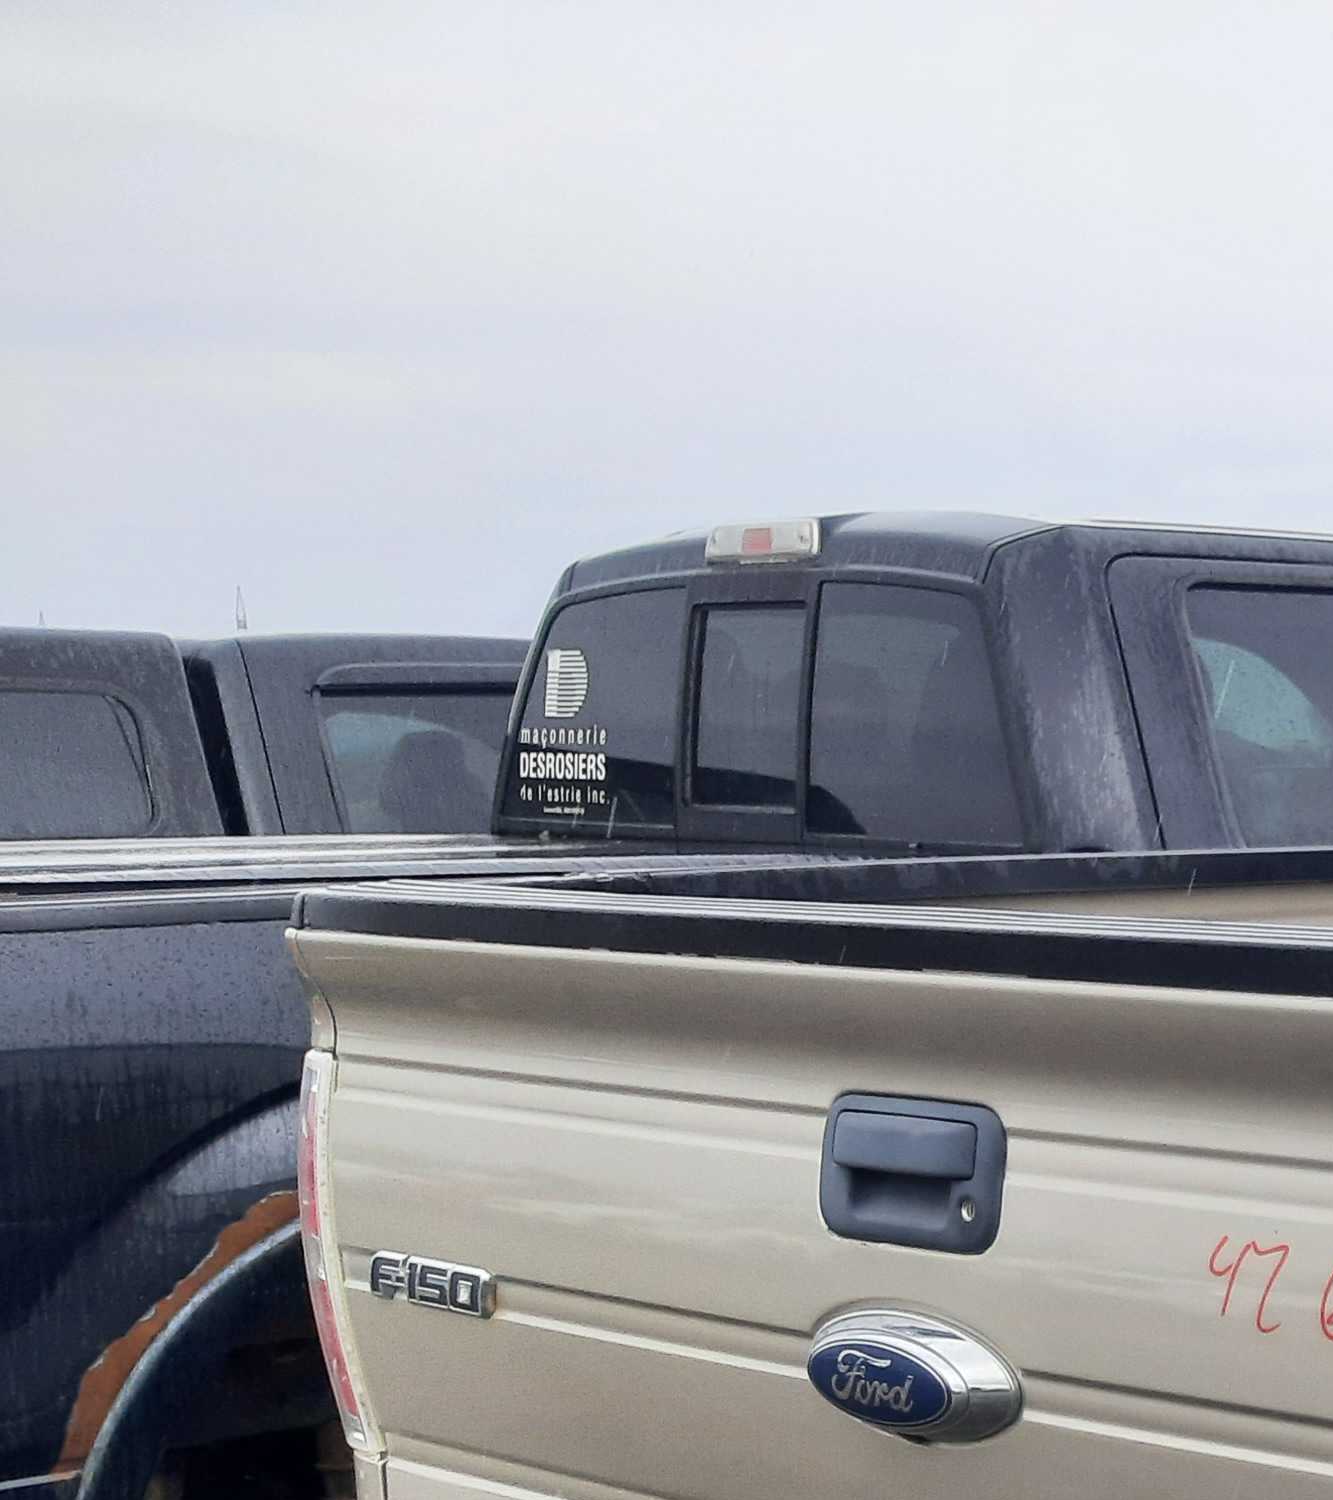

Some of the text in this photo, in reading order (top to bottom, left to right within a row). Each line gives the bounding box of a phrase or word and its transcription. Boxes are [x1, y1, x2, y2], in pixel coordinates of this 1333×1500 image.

[519, 724, 607, 749] maçonnerie
[519, 751, 606, 781] DESROSIERS
[520, 784, 533, 801] de
[587, 785, 611, 805] inc.
[831, 1349, 914, 1413] Ford
